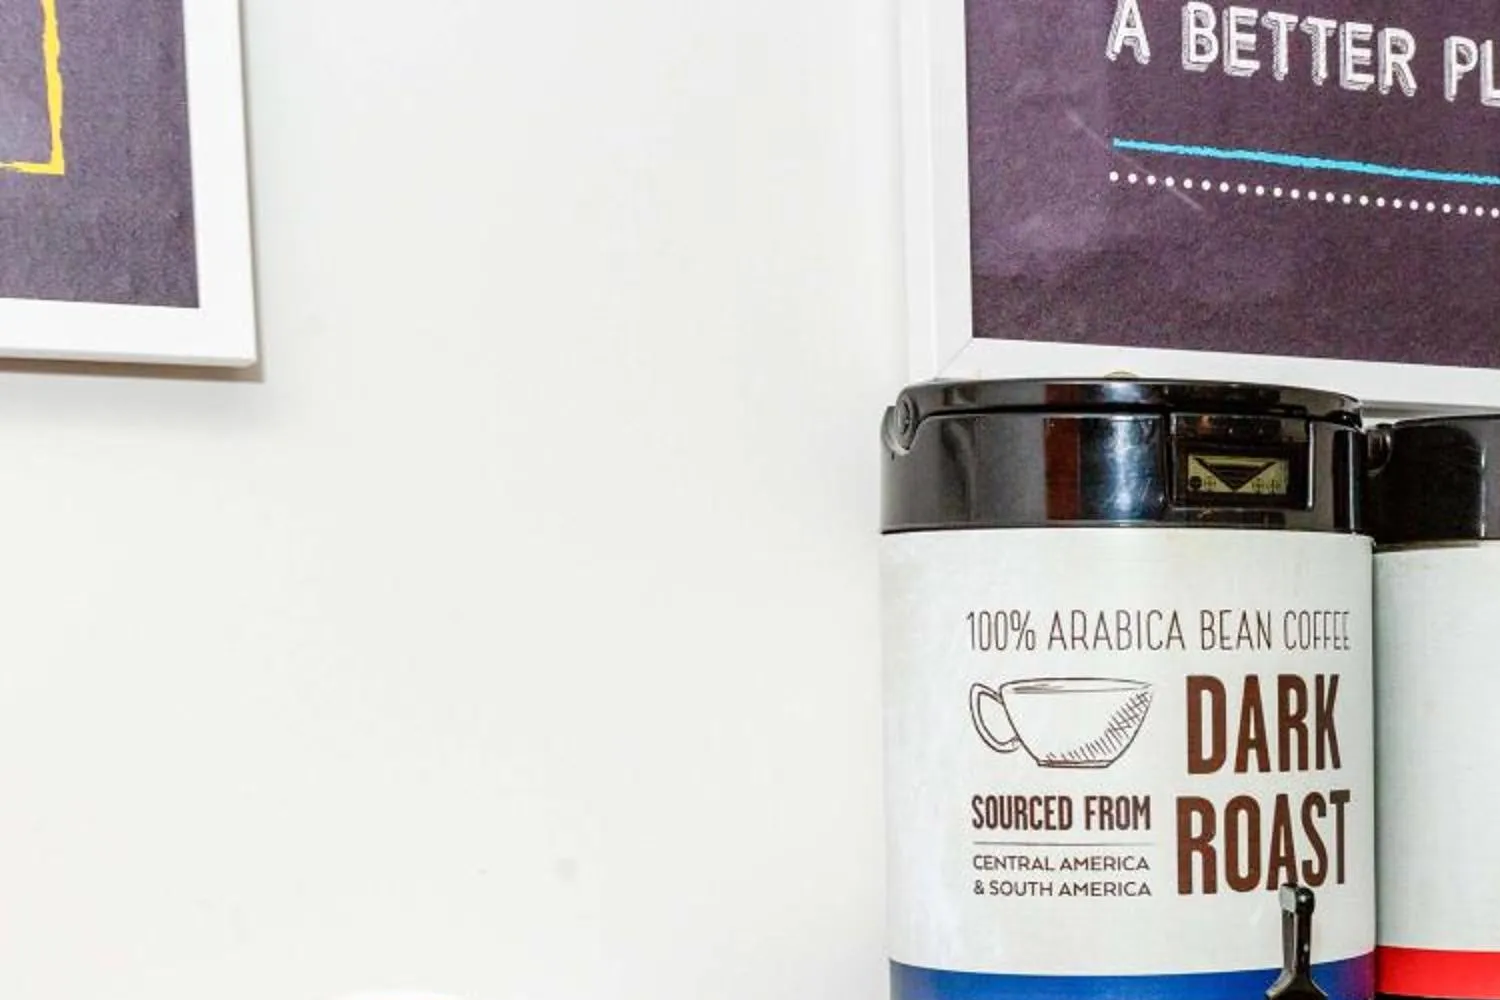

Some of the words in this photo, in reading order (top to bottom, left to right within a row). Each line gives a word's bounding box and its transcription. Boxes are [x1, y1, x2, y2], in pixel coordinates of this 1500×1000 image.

[1105, 4, 1151, 65] A
[1181, 1, 1418, 98] BETTER
[966, 609, 1036, 651] 100%
[1047, 609, 1186, 651] ARABICA
[1200, 609, 1272, 650] BEAN
[1283, 609, 1351, 651] COFFEE
[1185, 673, 1342, 775] DARK
[971, 794, 1073, 831] SOURCED
[1084, 795, 1151, 831] FROM
[973, 855, 1056, 872] CENTRAL
[1059, 854, 1151, 872] AMERICA
[1175, 789, 1351, 895] ROAST
[973, 879, 985, 896] &
[989, 879, 1053, 897] SOUTH
[1058, 879, 1153, 897] AMERICA
